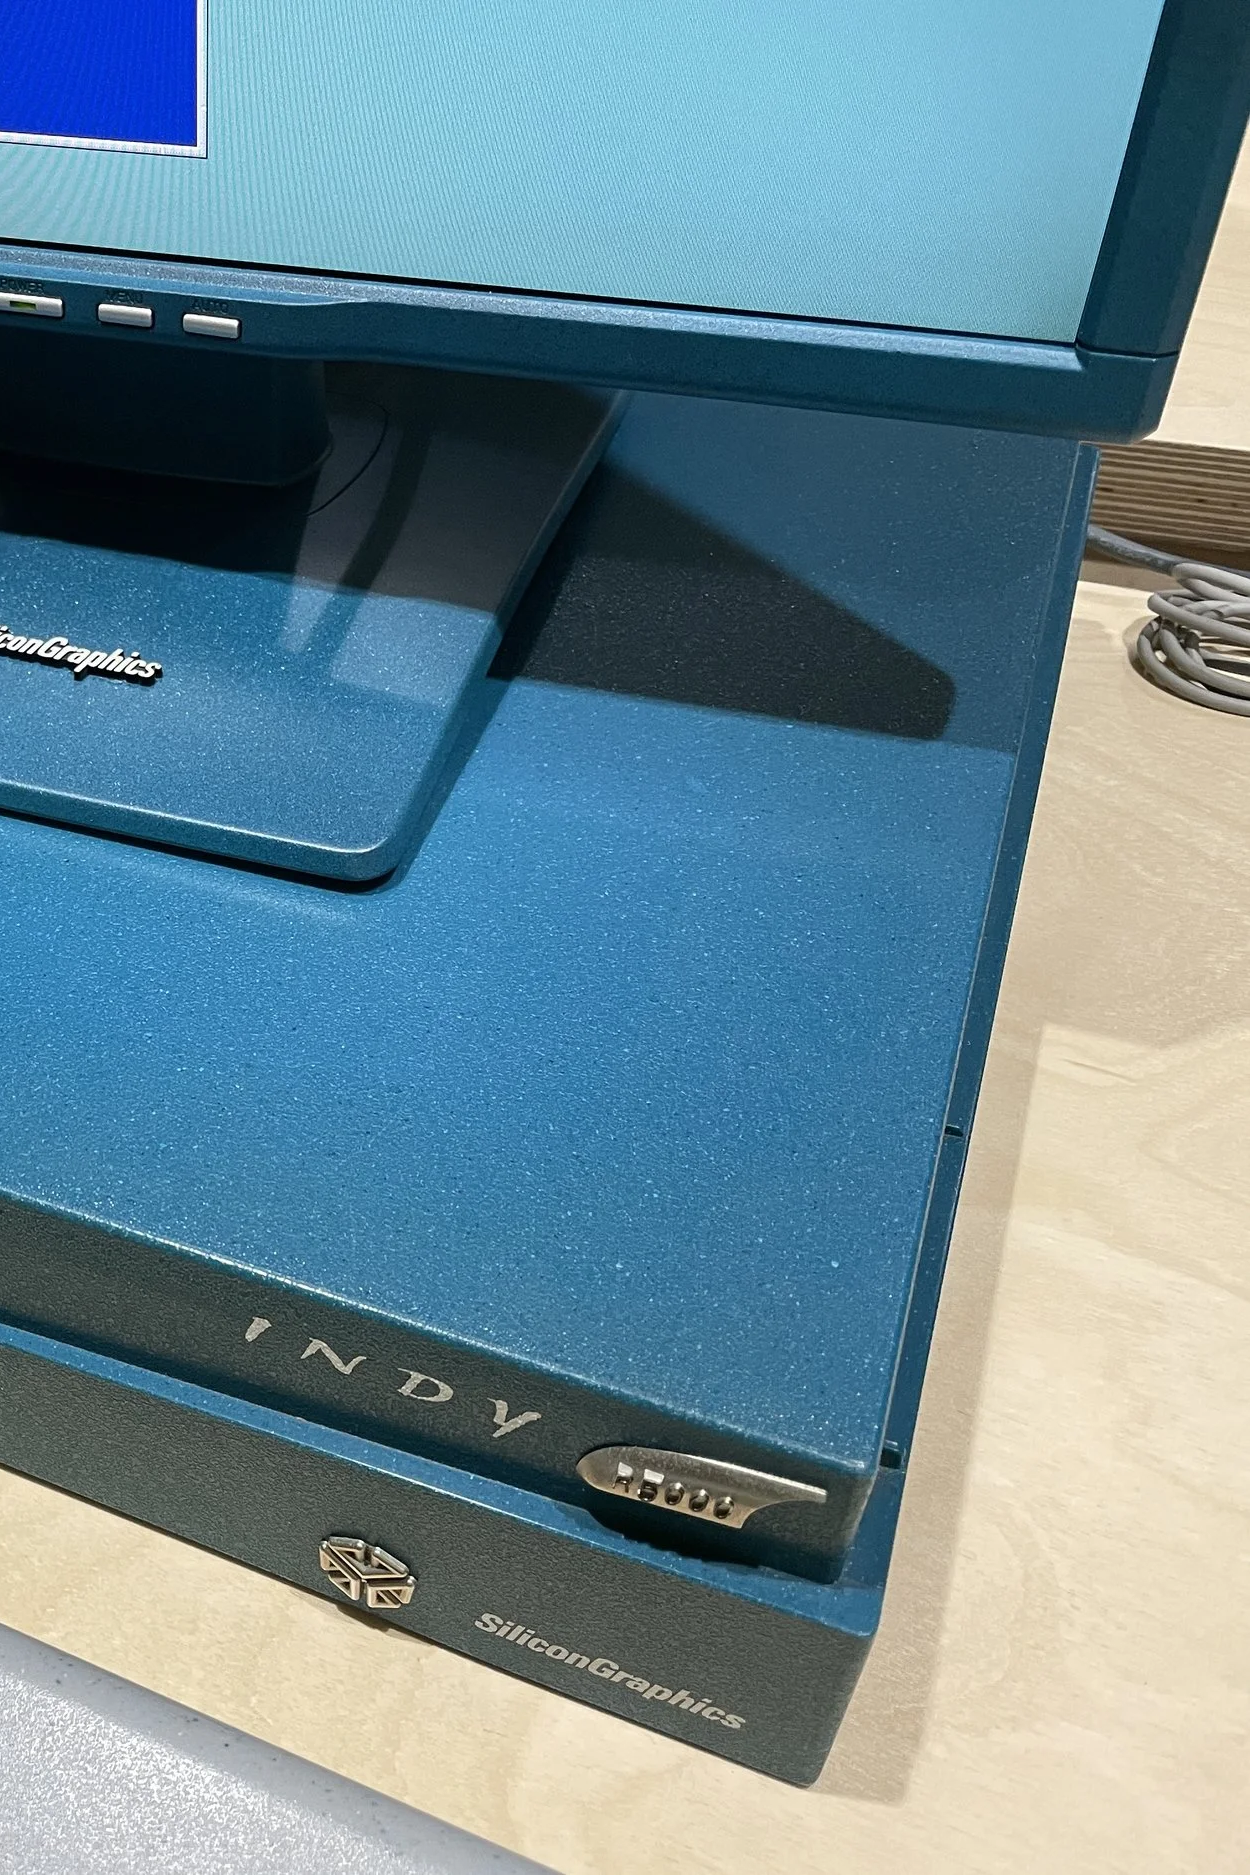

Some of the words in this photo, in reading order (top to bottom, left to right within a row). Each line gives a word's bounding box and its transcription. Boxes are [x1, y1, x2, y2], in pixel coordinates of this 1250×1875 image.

[0, 278, 45, 295] POWER
[244, 1316, 542, 1439] INDY
[474, 1611, 747, 1731] SiliconGraphics
